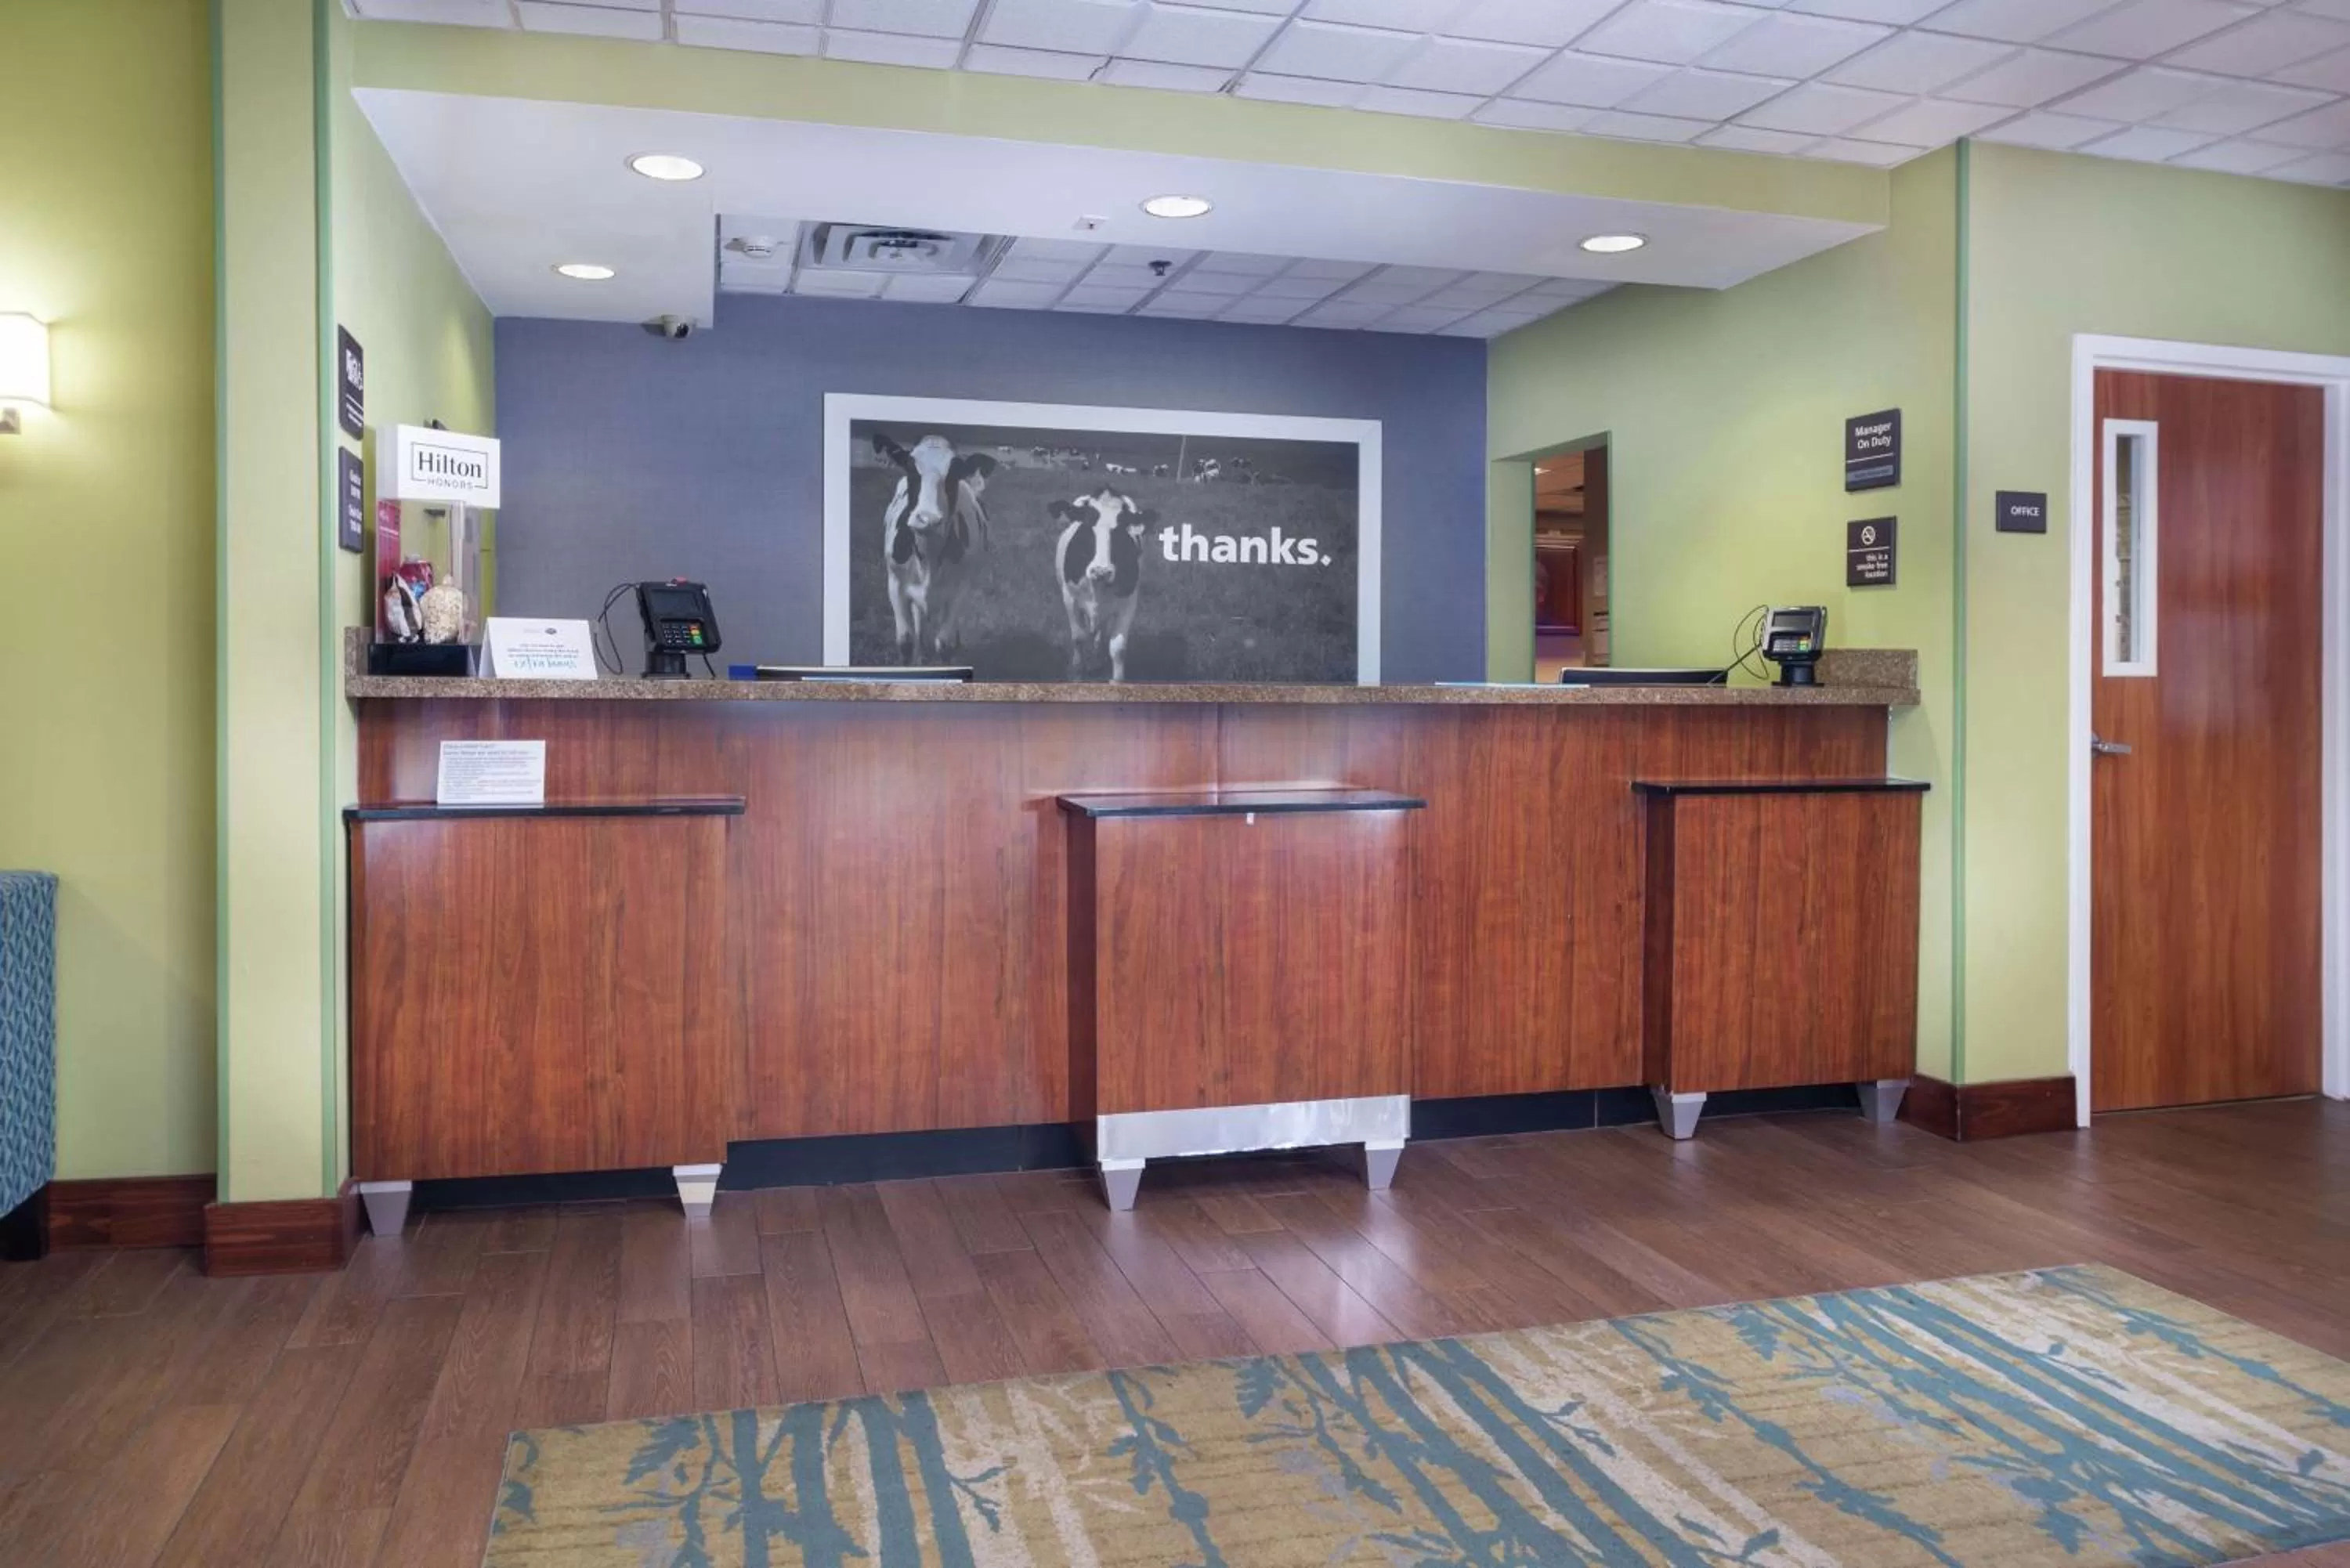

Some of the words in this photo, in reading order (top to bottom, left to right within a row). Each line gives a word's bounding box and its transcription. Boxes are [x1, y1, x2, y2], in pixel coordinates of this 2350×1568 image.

[1855, 422, 1893, 436] Manager
[1857, 439, 1870, 450] On
[1871, 435, 1892, 448] Duty
[419, 451, 481, 478] Hilton
[428, 477, 473, 490] HONORS
[2011, 505, 2041, 517] OFFICE
[1159, 522, 1332, 567] thanks.
